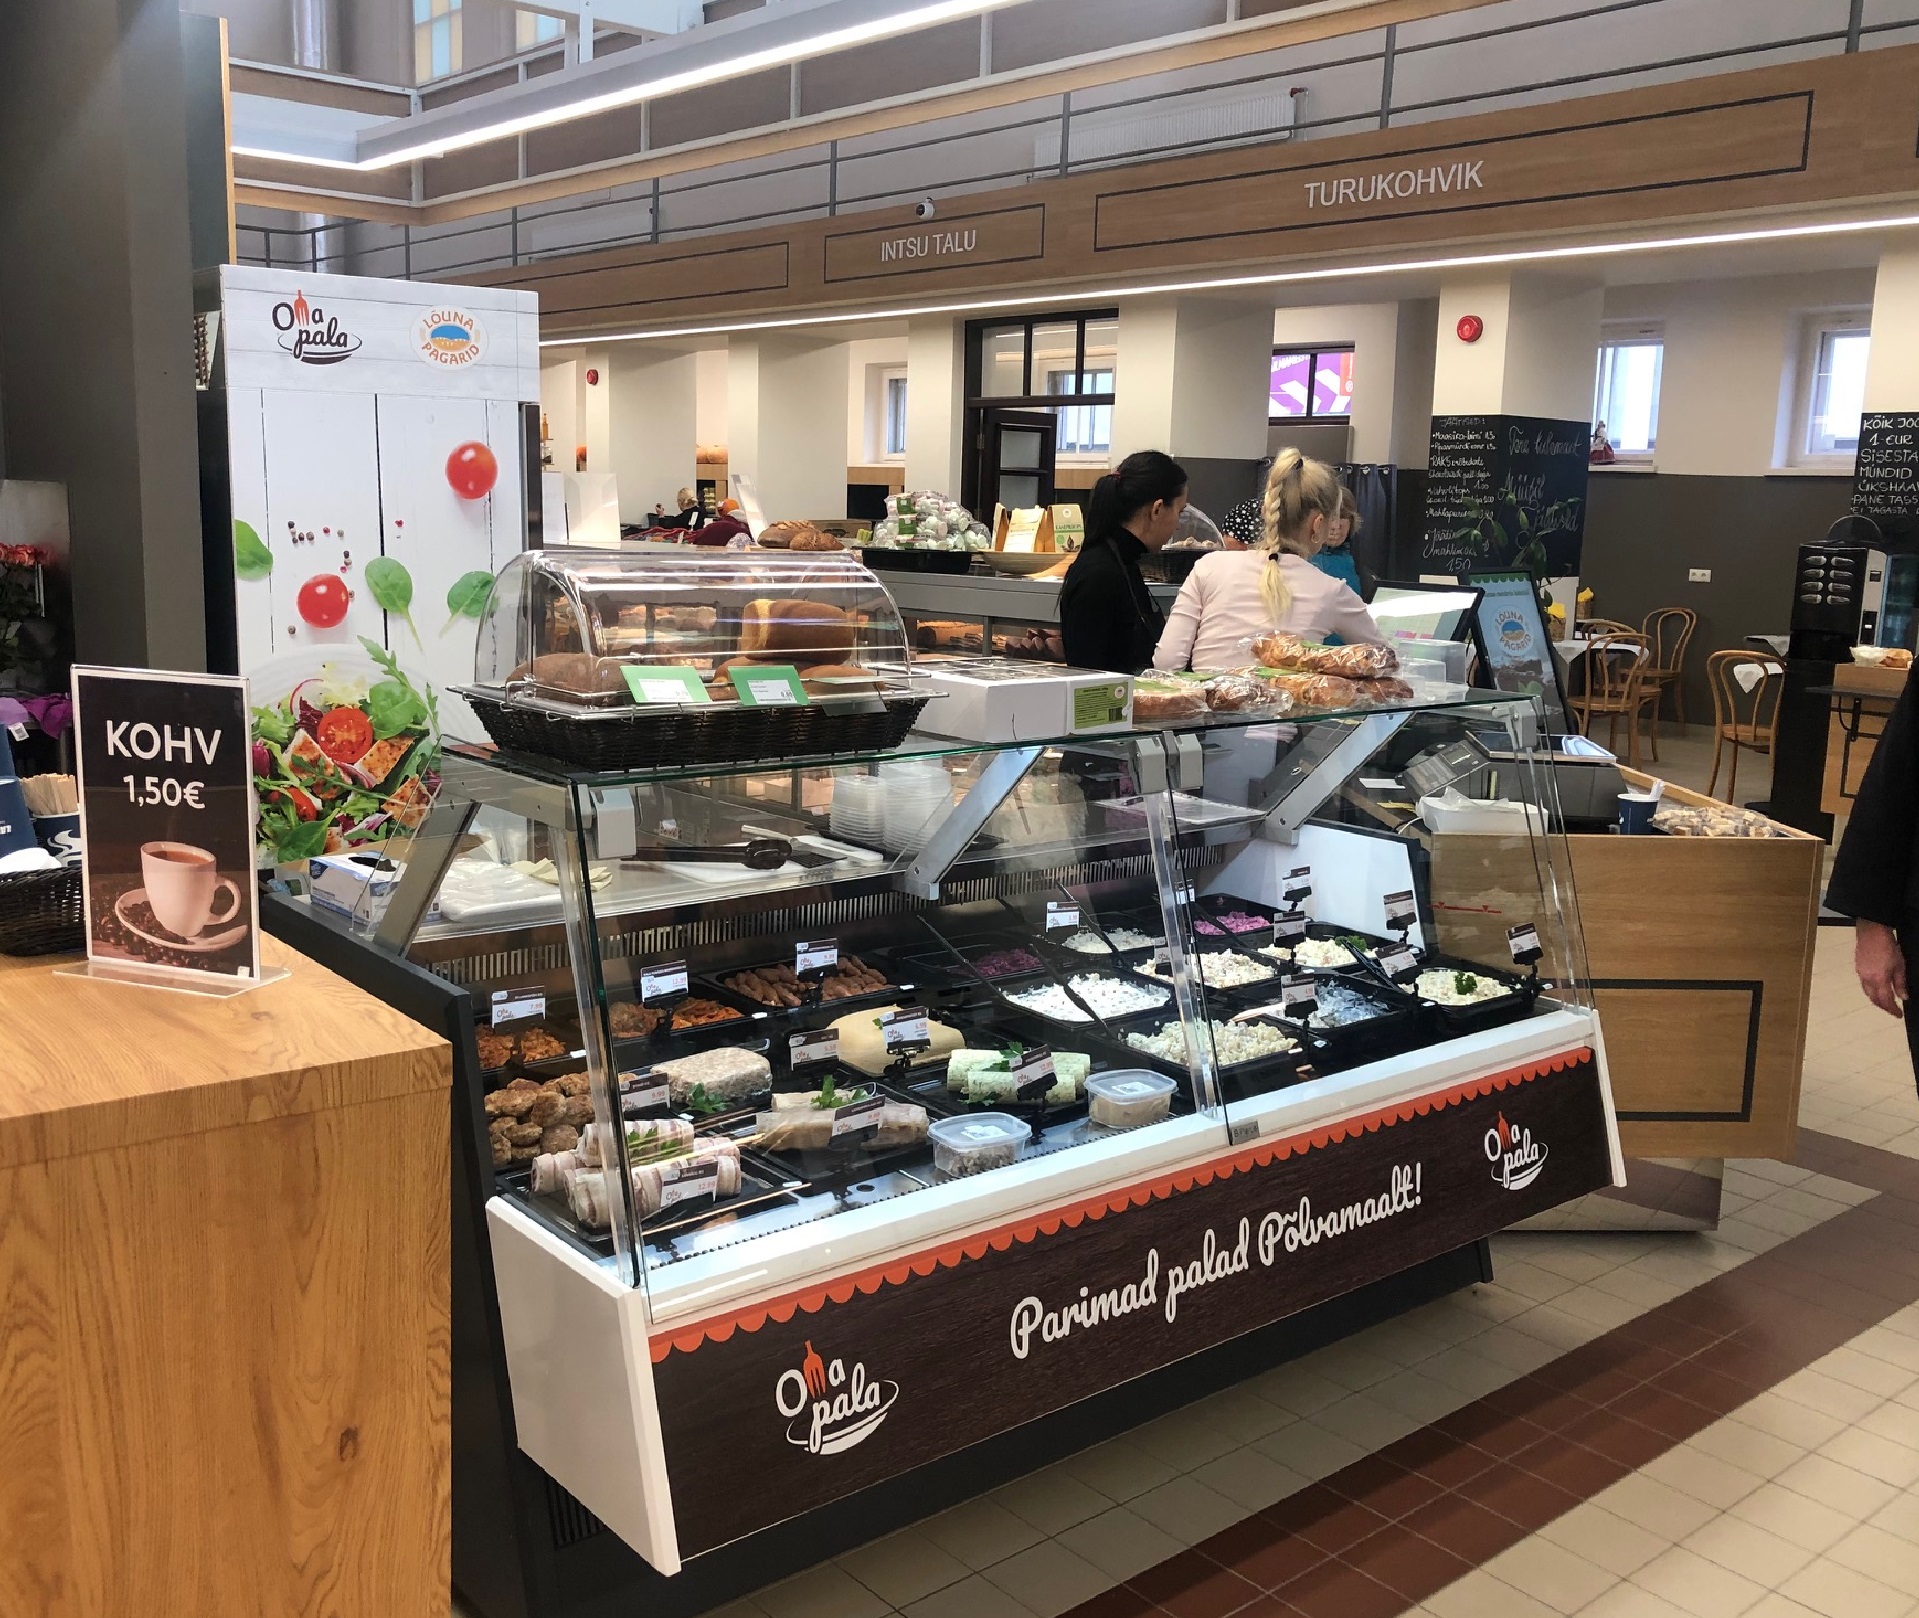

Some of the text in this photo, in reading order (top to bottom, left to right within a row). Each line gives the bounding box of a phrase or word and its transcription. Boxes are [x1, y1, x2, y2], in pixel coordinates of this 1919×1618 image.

[1303, 160, 1484, 209] TURUKOHVIK
[881, 229, 976, 262] INTSU TALU
[293, 316, 348, 359] pala
[422, 309, 474, 331] LÕUNA
[421, 341, 480, 365] PAGARID
[1859, 464, 1913, 480] MÜNDID
[1853, 494, 1885, 506] PANE
[106, 719, 222, 765] KOHV
[122, 774, 206, 810] 1,50€
[1502, 1127, 1539, 1189] pala
[1010, 1162, 1422, 1360] Parimad palad Põlvamaalt!
[809, 1361, 881, 1454] pala
